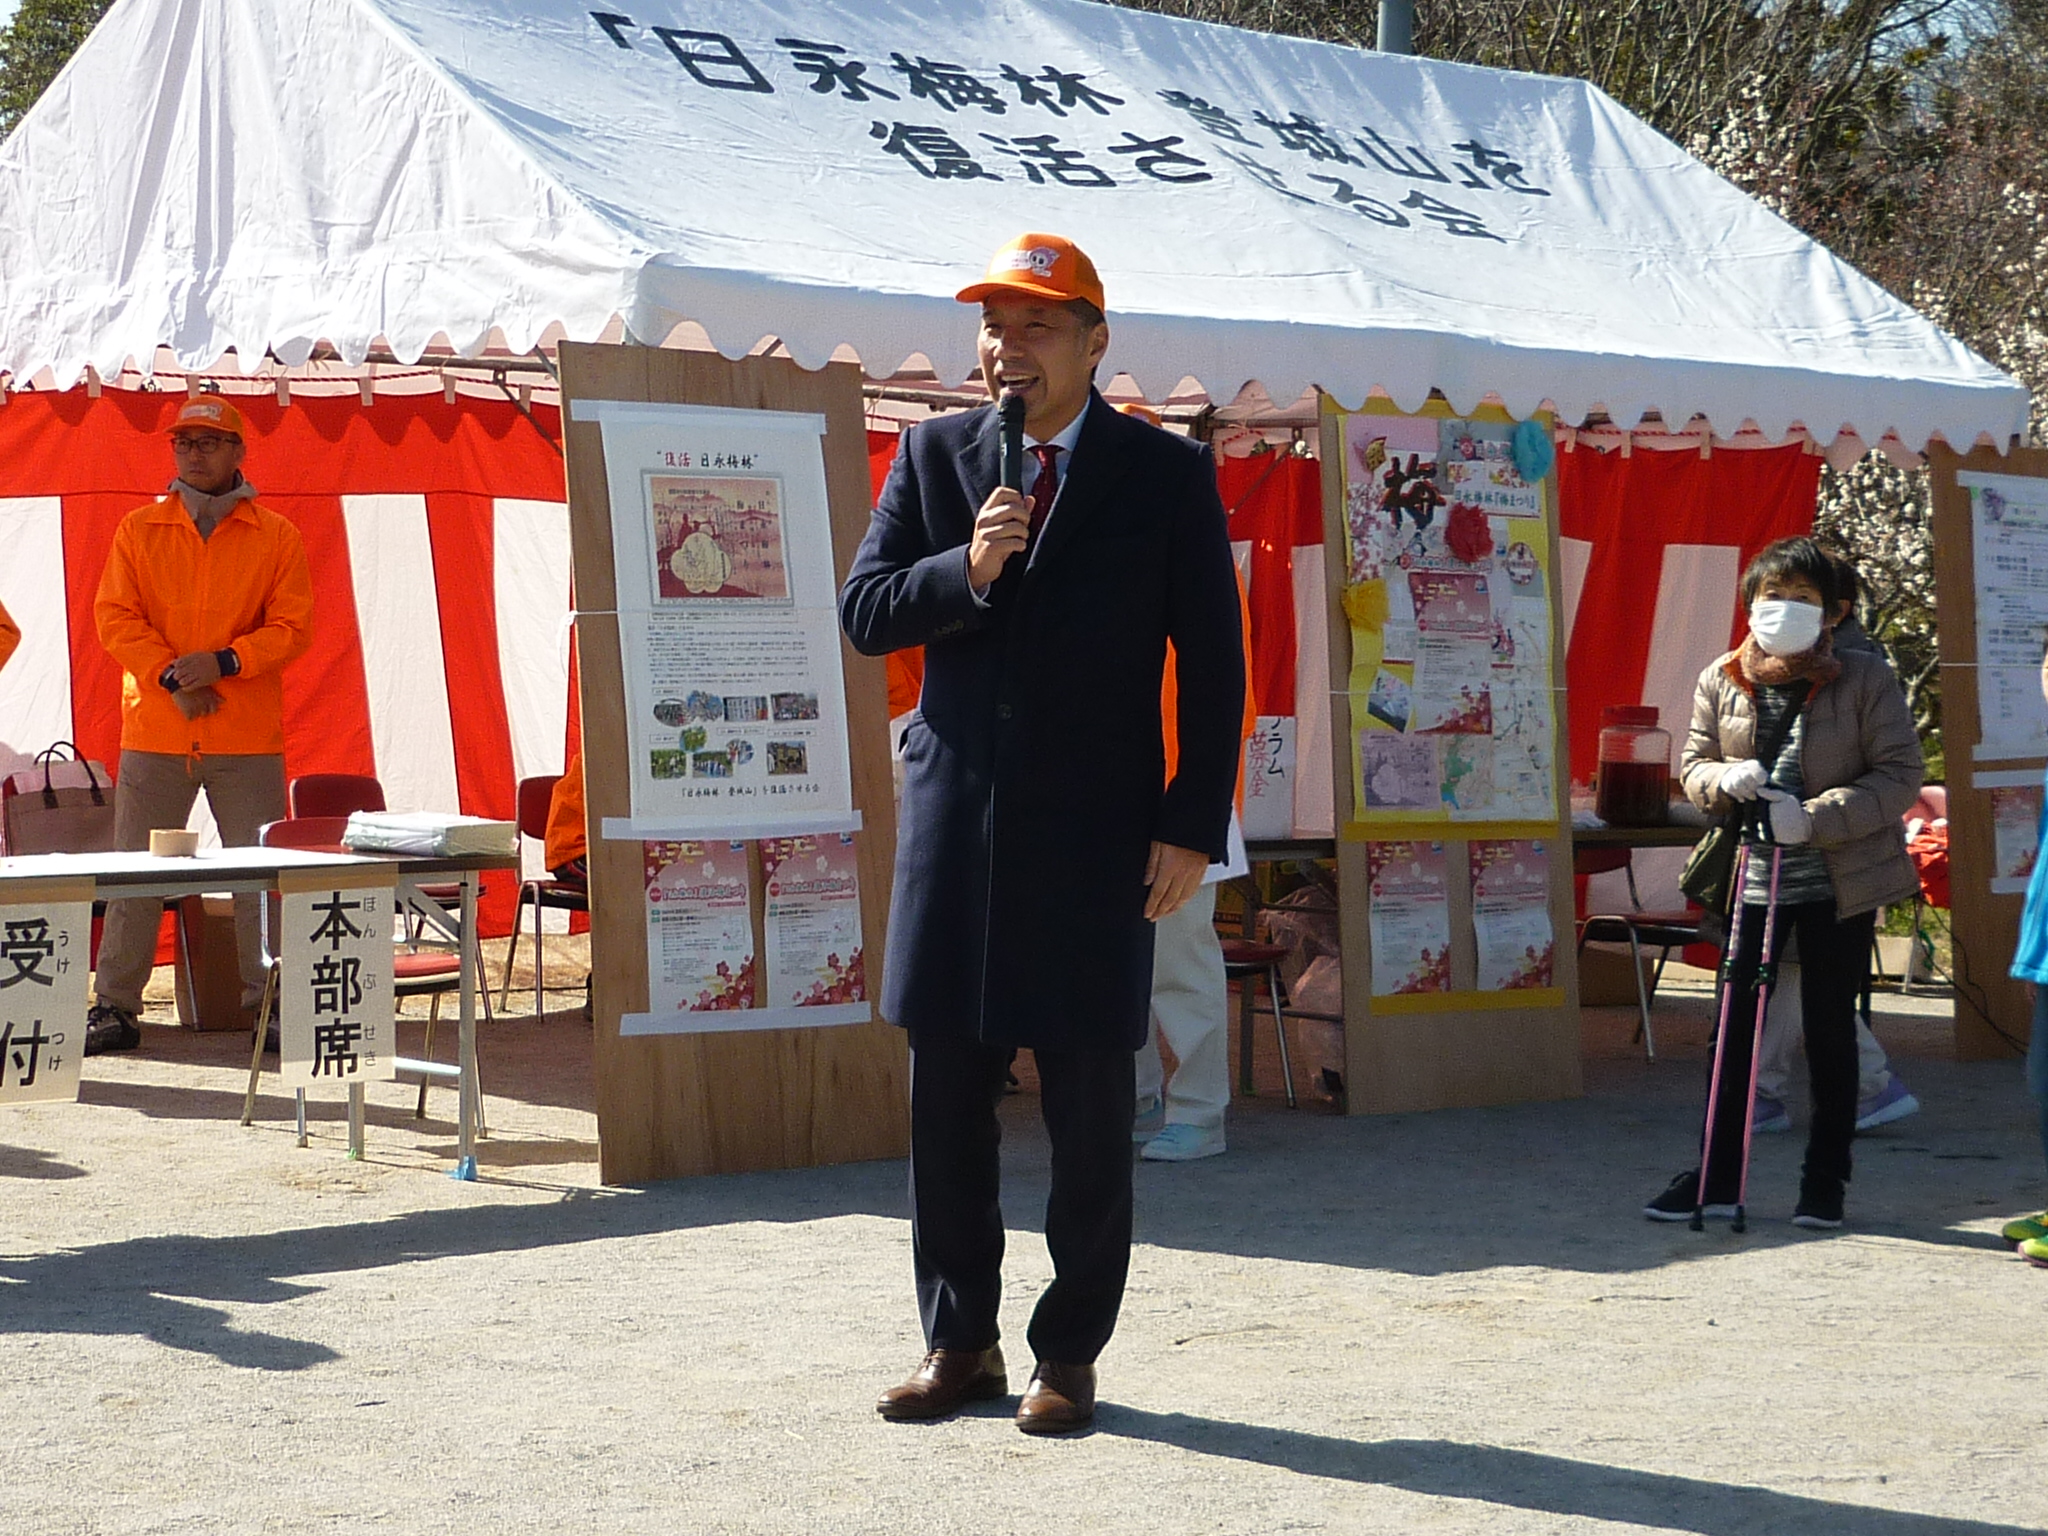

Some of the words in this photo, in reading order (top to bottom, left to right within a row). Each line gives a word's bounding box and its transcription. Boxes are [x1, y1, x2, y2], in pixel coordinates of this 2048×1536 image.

[869, 120, 1508, 244] 復活させる会
[362, 896, 377, 939] ほん
[56, 929, 71, 974] うけ
[0, 917, 54, 1088] 受付
[310, 891, 364, 1079] 本部席
[362, 973, 377, 990] ぶ
[48, 1031, 66, 1072] つけ
[363, 1025, 377, 1067] せき
